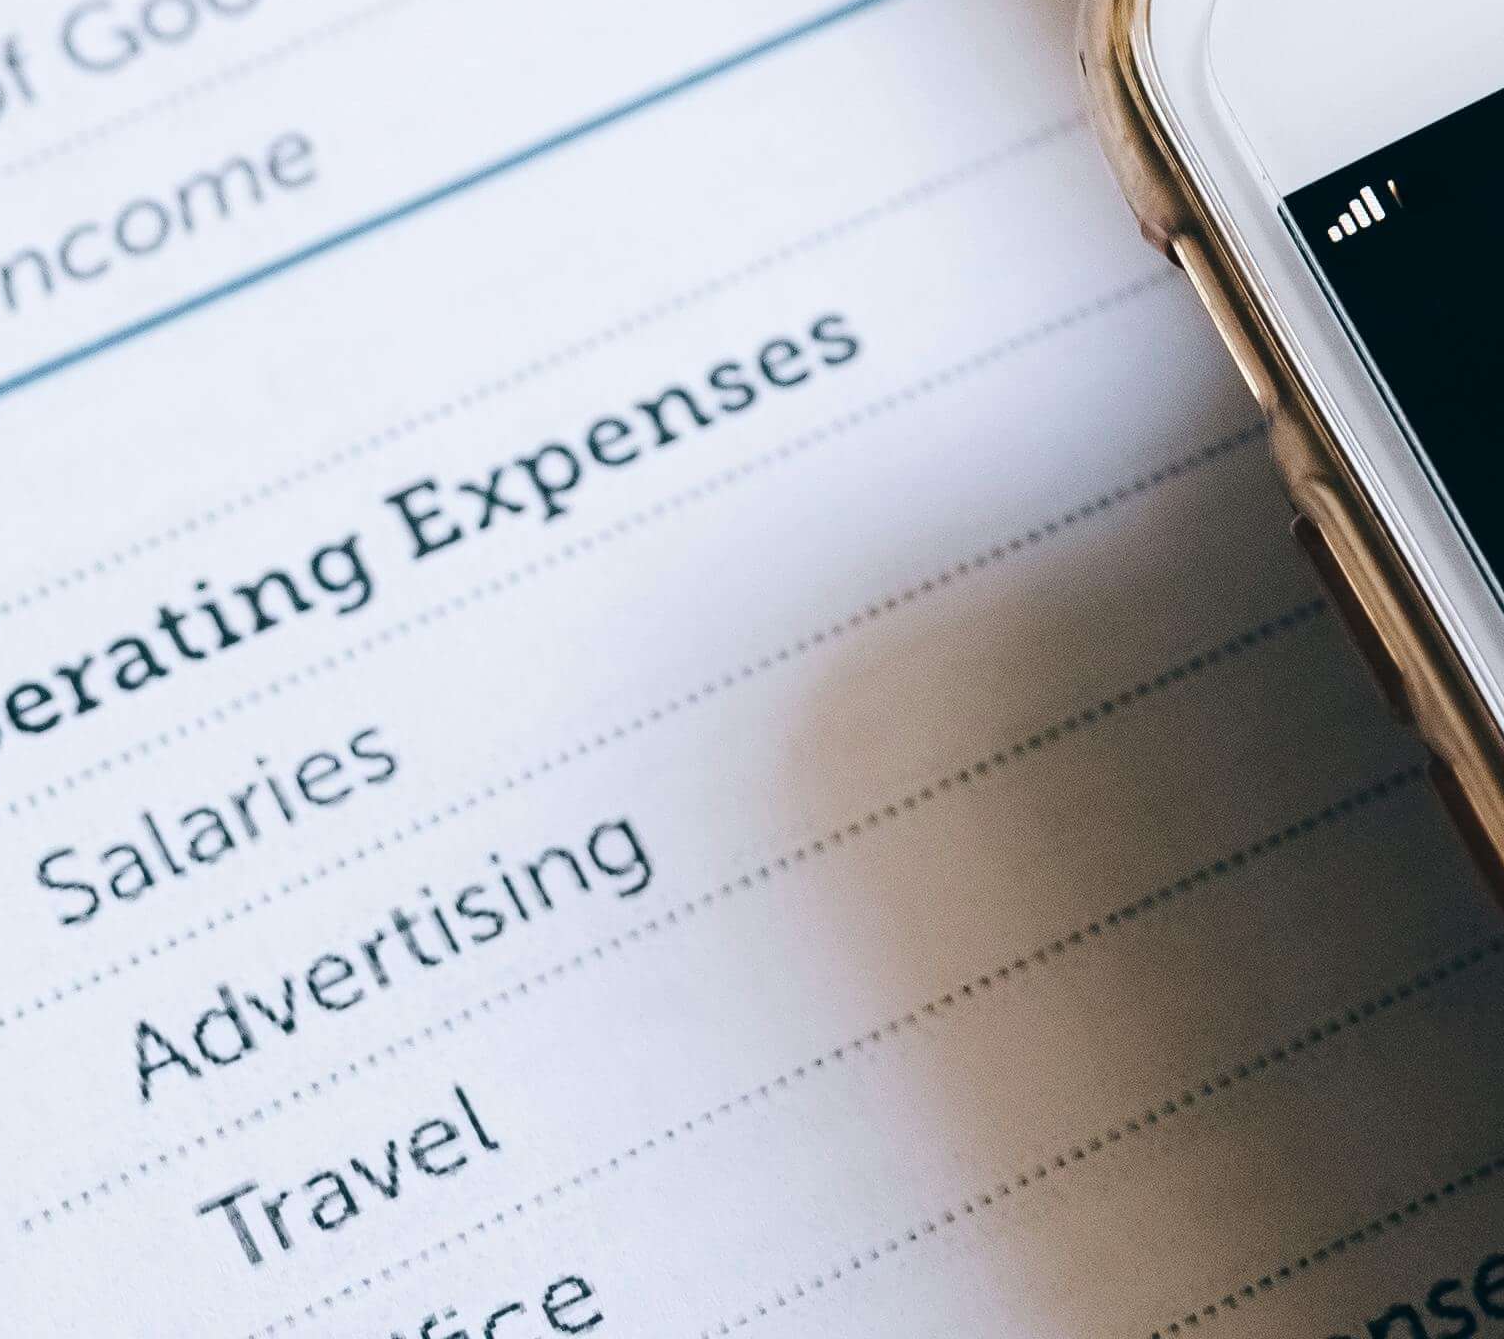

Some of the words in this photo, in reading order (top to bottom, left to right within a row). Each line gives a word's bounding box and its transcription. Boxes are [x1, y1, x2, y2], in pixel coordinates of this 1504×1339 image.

[381, 312, 863, 563] Expenses
[33, 725, 400, 929] Salaries
[133, 815, 657, 1104] Advertising
[198, 1083, 502, 1267] Travel
